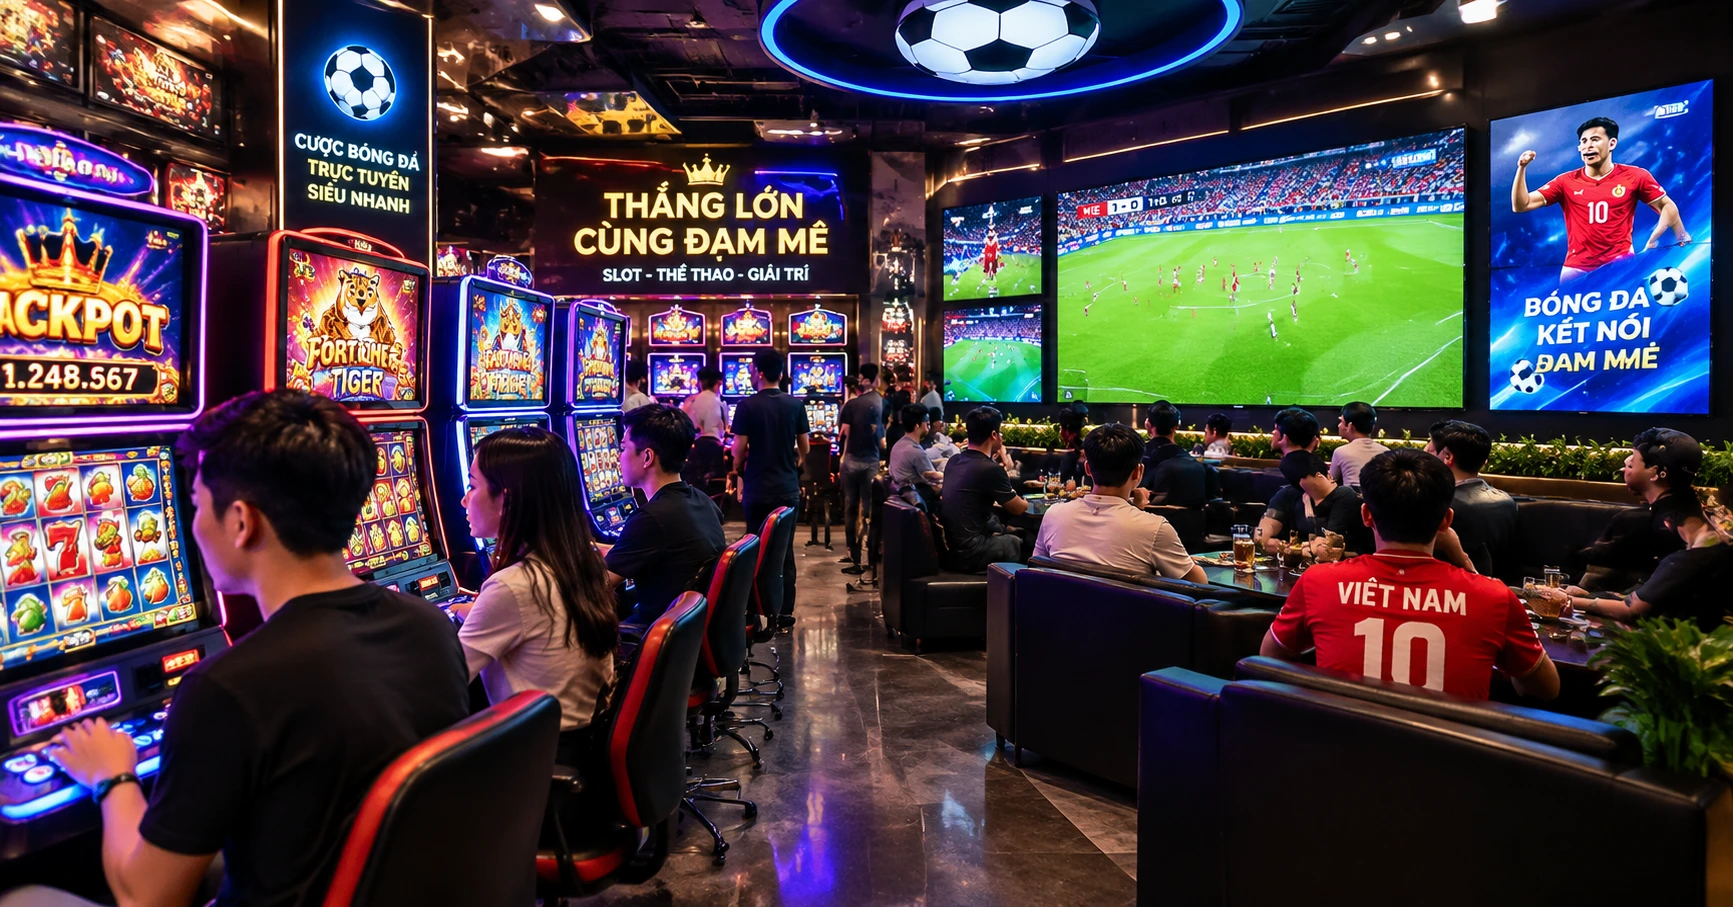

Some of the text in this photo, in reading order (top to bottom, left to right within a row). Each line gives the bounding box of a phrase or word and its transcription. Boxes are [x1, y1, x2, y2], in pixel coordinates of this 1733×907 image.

[294, 132, 344, 157] CƯỢC
[307, 158, 353, 183] TRỰC
[307, 182, 410, 214] SIÊU NHANH
[603, 180, 803, 219] THẮNG LỚN
[1587, 201, 1609, 224] 10
[573, 220, 674, 255] CÙNG
[778, 219, 829, 255] MÊ
[602, 267, 643, 282] SLOT
[690, 267, 735, 282] THAO
[783, 263, 810, 281] TRÍ
[1524, 288, 1602, 317] BÓNG
[331, 368, 384, 398] TIGER
[1402, 587, 1467, 616] NAM
[1354, 617, 1446, 692] 10
